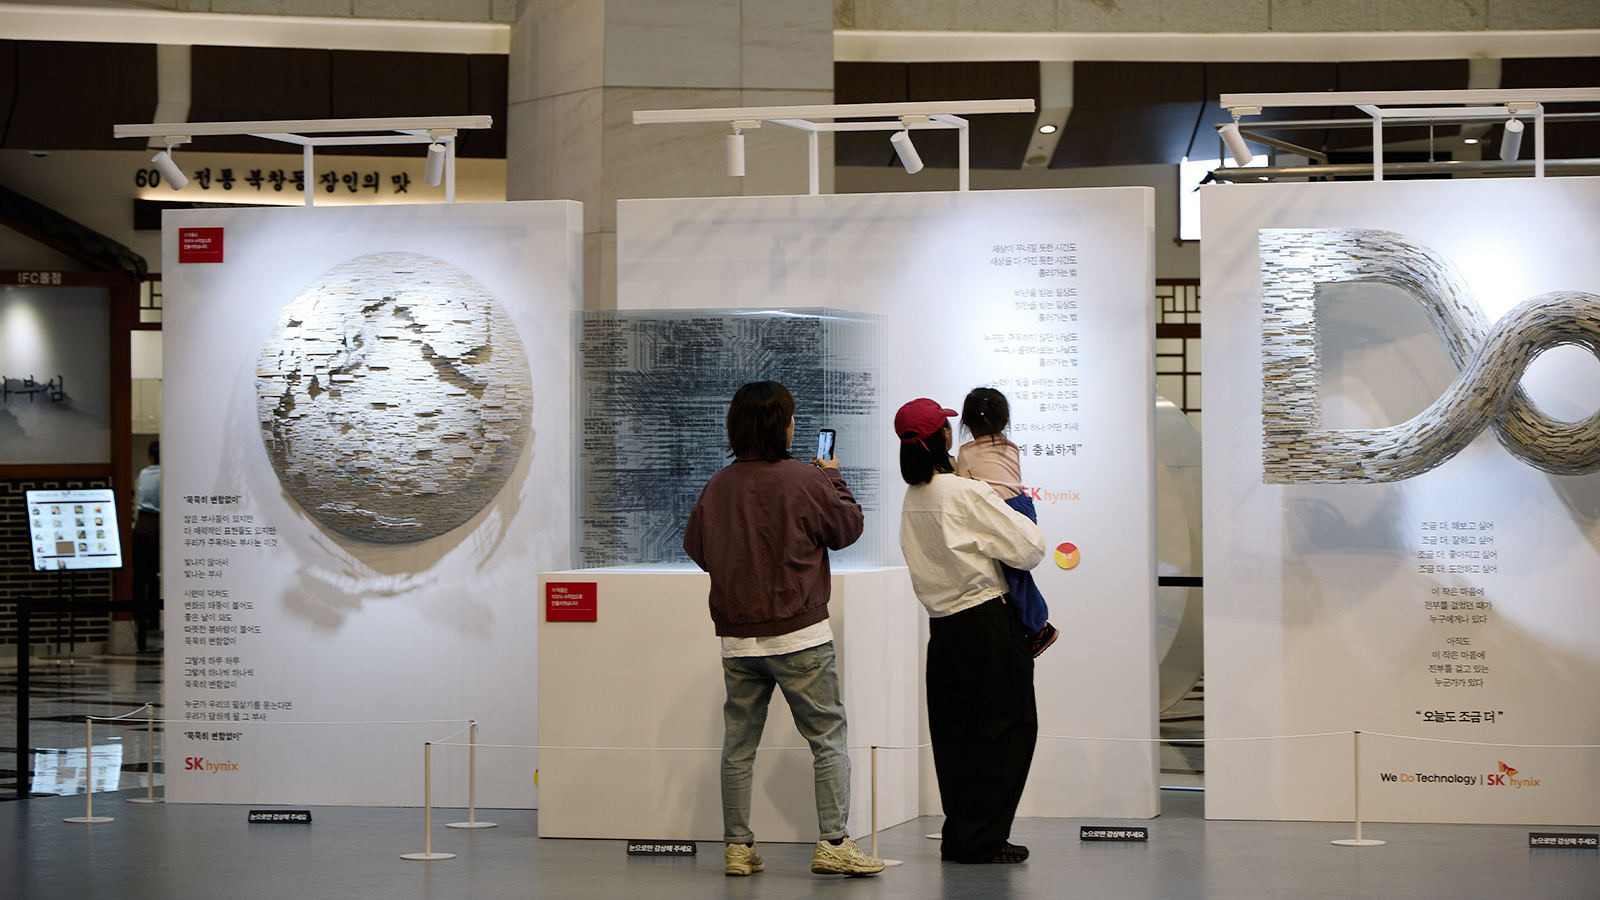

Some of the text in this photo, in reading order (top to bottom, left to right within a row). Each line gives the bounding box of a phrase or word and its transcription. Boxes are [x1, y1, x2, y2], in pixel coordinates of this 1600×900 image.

[135, 168, 411, 193] 60 전통 북창동 장인의 맛
[1044, 489, 1080, 504] hynix
[1422, 521, 1493, 530] 조금 해보고 싶어
[1422, 536, 1493, 545] 조금 잘하고 싶어
[1418, 550, 1497, 559] 조금 좋아지고 싶어
[1418, 565, 1497, 573] 조금 도전하고 싶어
[1431, 587, 1484, 596] 이 작은 마음에
[1425, 601, 1492, 610] 전부를 걸었던 때가
[1429, 615, 1487, 624] 누구에게나 있다
[1447, 637, 1471, 646] 아직도
[1432, 651, 1485, 660] 이 작은 마음에
[1429, 664, 1489, 673] 전부를 걸고 있는
[1434, 678, 1484, 687] 누군가가 있다
[1459, 710, 1482, 724] 조금
[184, 757, 238, 774] SK hynix
[1381, 773, 1397, 782] We
[1416, 773, 1477, 786] Technology
[1487, 774, 1540, 789] SK hynix
